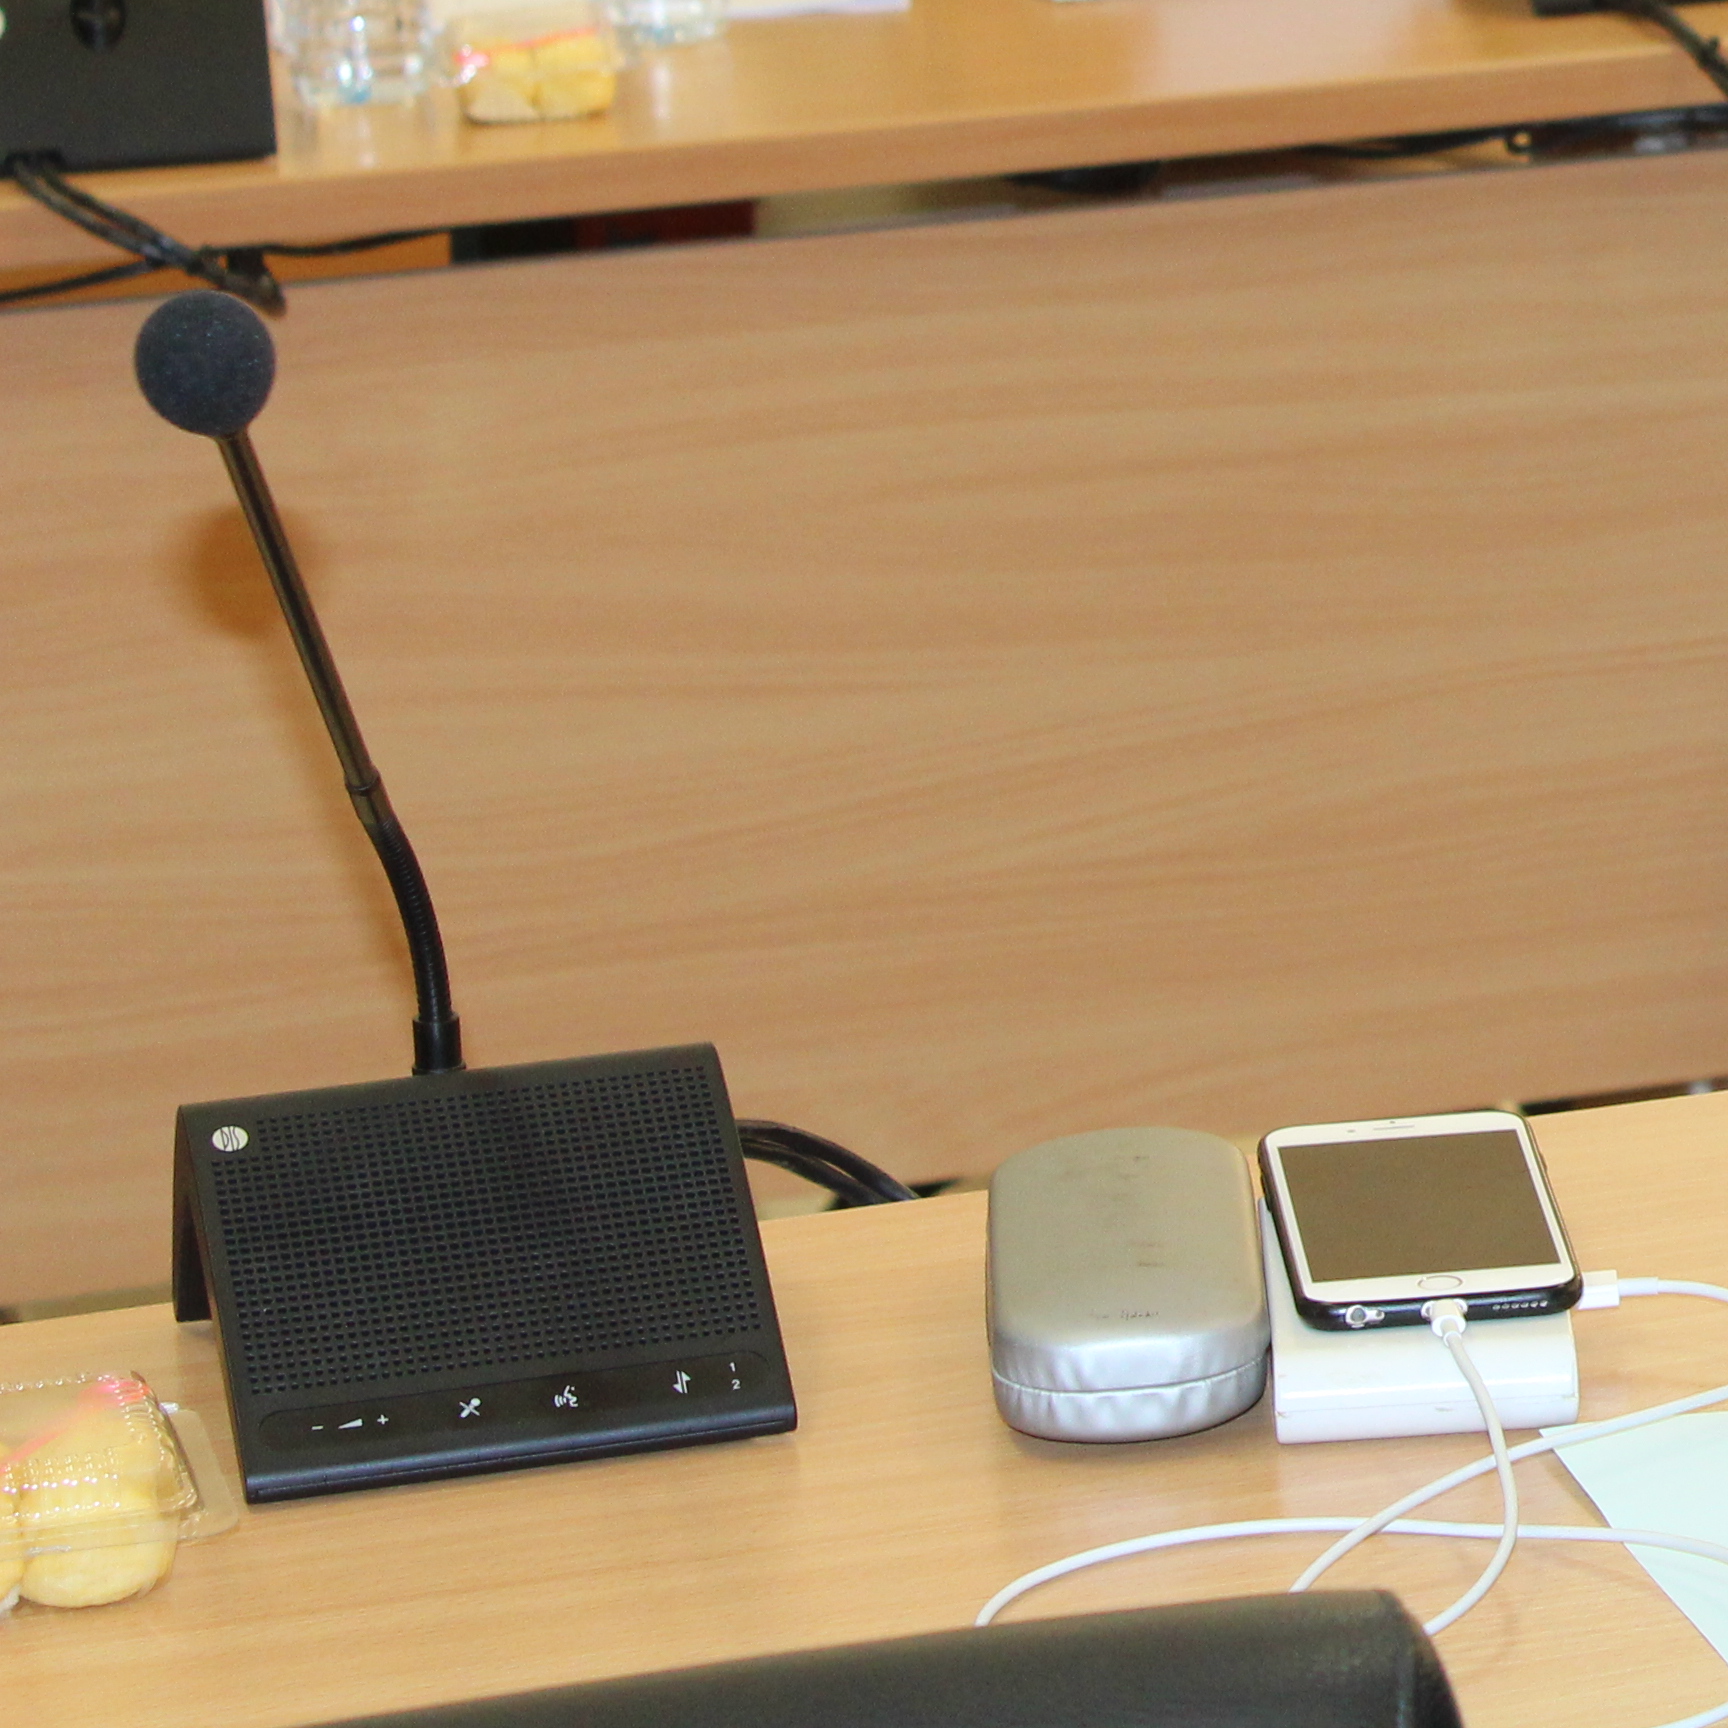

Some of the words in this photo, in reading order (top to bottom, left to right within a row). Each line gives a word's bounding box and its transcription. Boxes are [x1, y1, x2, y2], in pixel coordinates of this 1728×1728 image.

[220, 1126, 240, 1152] DIS
[729, 1362, 736, 1372] 1
[731, 1378, 741, 1390] 2
